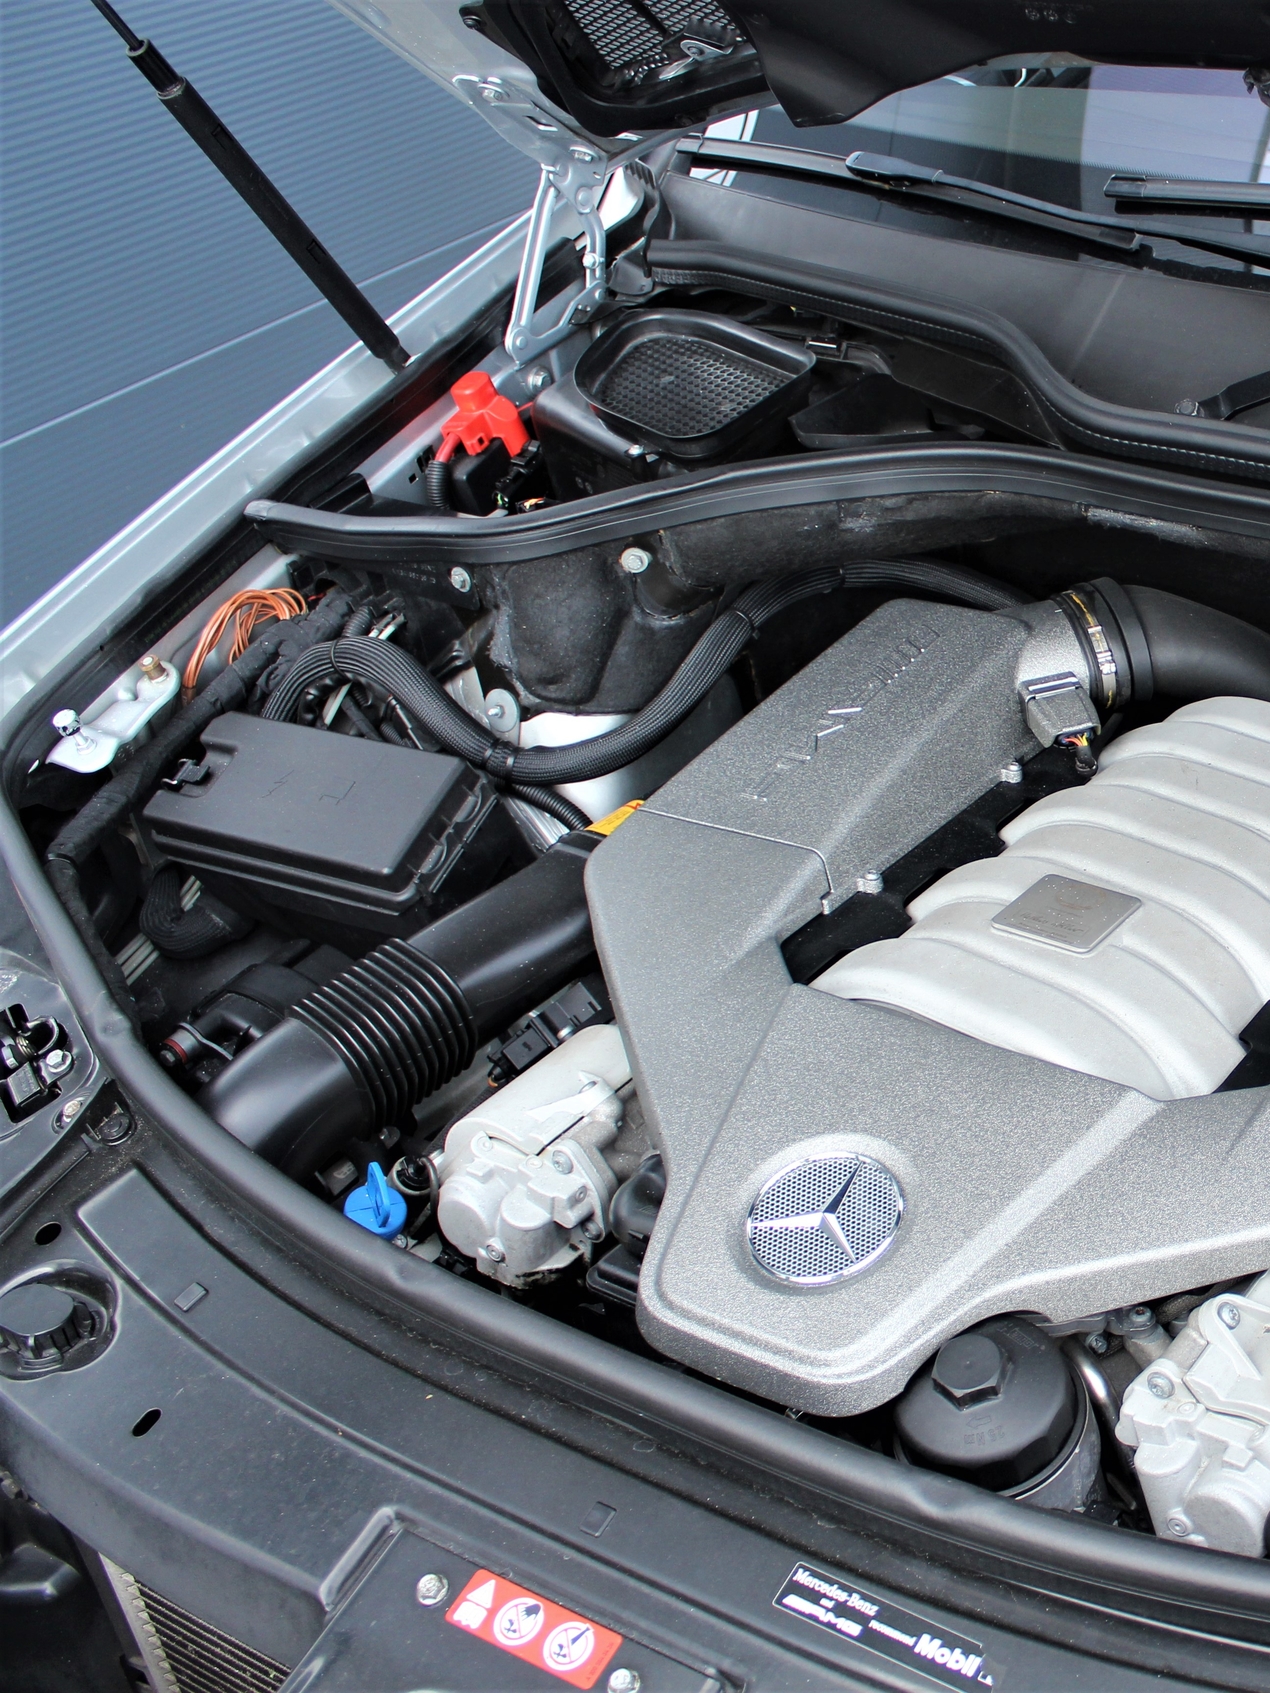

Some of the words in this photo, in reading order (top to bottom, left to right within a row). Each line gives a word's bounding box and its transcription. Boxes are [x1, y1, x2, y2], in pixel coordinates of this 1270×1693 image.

[793, 1568, 879, 1616] Mercedes-Benz
[869, 1620, 917, 1647] recommend
[914, 1633, 982, 1677] Mobil
